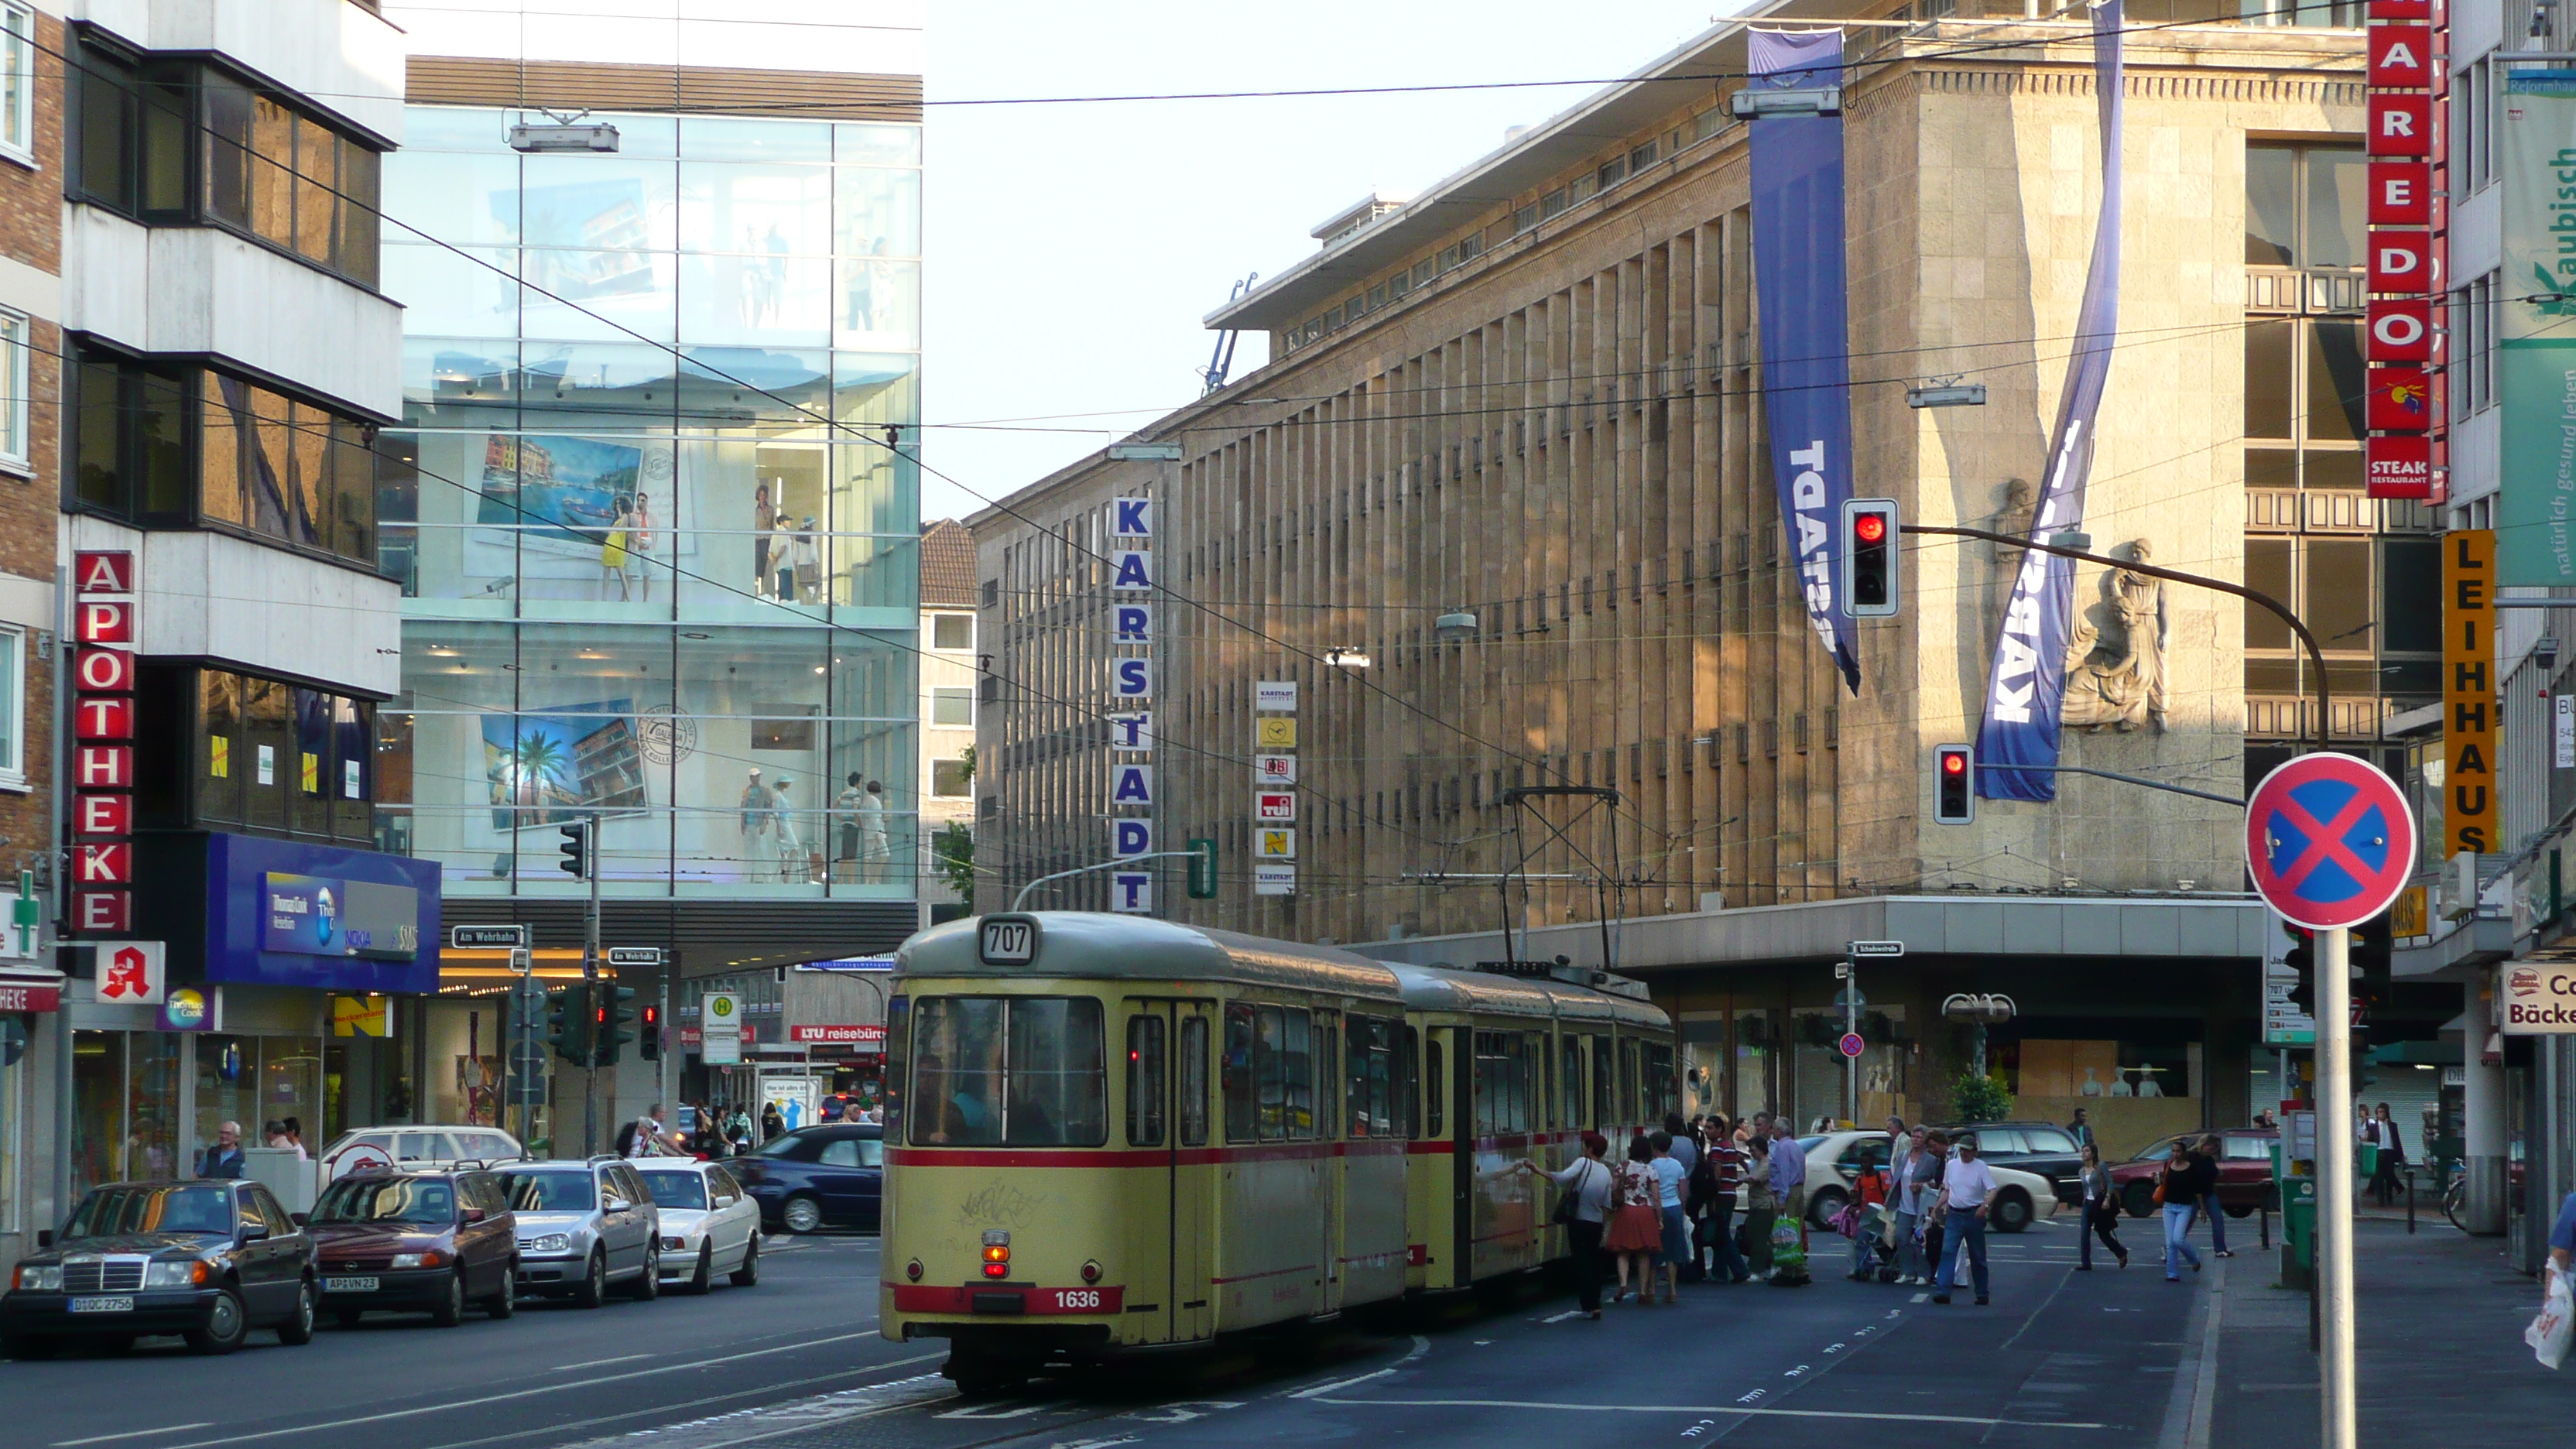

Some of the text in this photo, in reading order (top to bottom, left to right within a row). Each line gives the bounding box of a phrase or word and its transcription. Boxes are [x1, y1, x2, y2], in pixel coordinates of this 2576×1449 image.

[2374, 0, 2424, 346] AREDO
[2372, 460, 2427, 474] STEAK
[2550, 369, 2576, 575] natürlich gesund leben
[2455, 539, 2486, 852] LEIHHAUS
[1115, 501, 1149, 909] KARSTADT
[83, 557, 122, 930] APOTHEKE
[345, 930, 371, 947] NOKIA
[460, 931, 516, 942] Am Wehrhahn
[988, 925, 1027, 954] 707
[168, 999, 204, 1009] Thomas
[181, 1008, 204, 1017] Cook
[335, 1009, 385, 1023] Neckermann
[801, 1028, 886, 1040] LTU reisebüro
[331, 1279, 342, 1288] AP
[363, 1279, 375, 1288] 23
[74, 1300, 80, 1310] D
[104, 1299, 132, 1310] 2756
[1055, 1291, 1100, 1308] 1636
